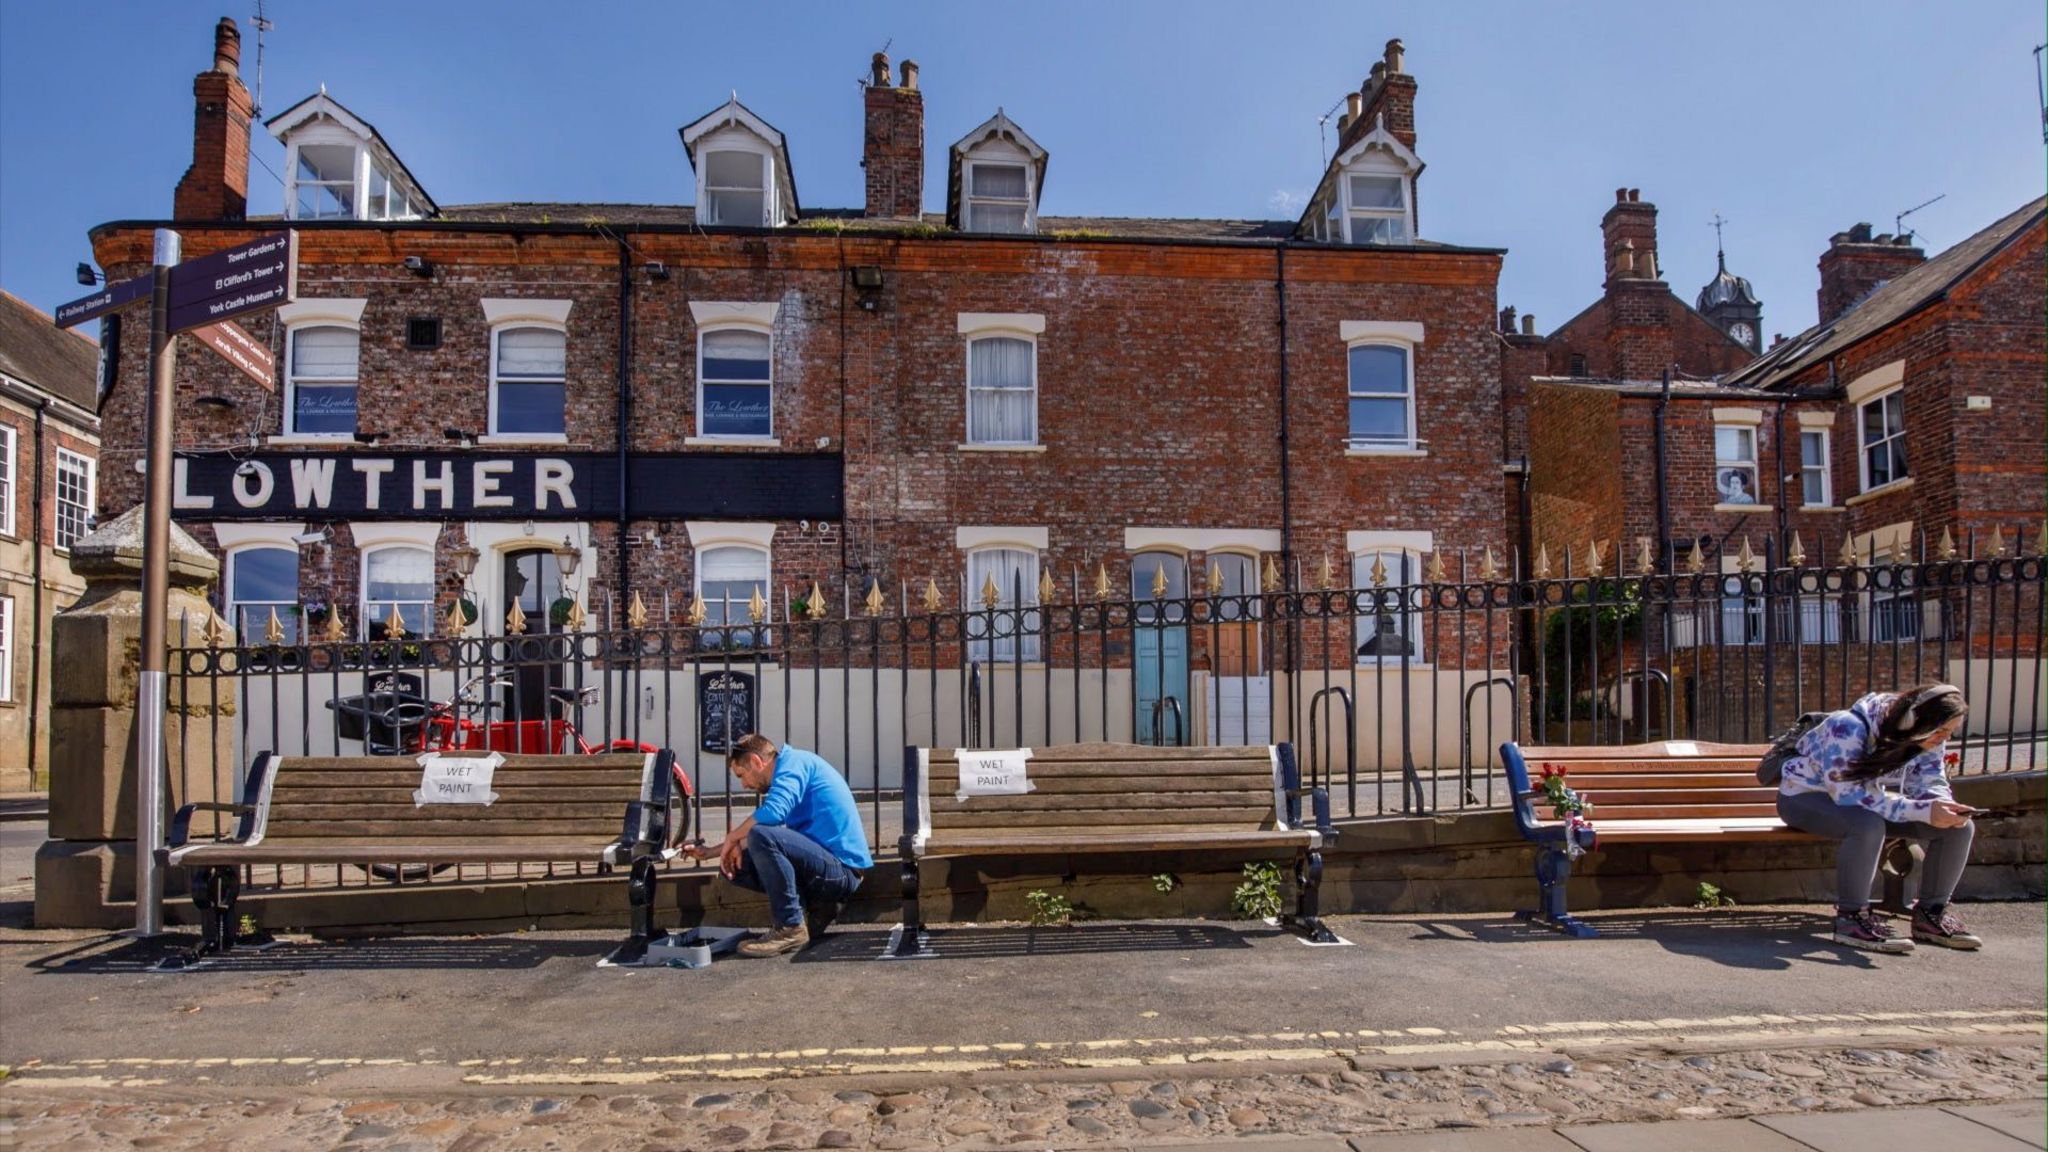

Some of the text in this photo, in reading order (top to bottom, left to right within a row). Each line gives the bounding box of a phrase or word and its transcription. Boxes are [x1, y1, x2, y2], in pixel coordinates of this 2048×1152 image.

[227, 242, 276, 264] Tower Gardens
[223, 266, 274, 287] Clifford's Tower
[65, 297, 105, 317] Railway Station
[209, 289, 274, 314] York Castle Museum
[173, 457, 578, 511] LOWTHER
[446, 767, 473, 777] WET
[979, 759, 1004, 769] WET
[438, 783, 473, 793] PAINT
[977, 775, 1009, 786] PAINT
